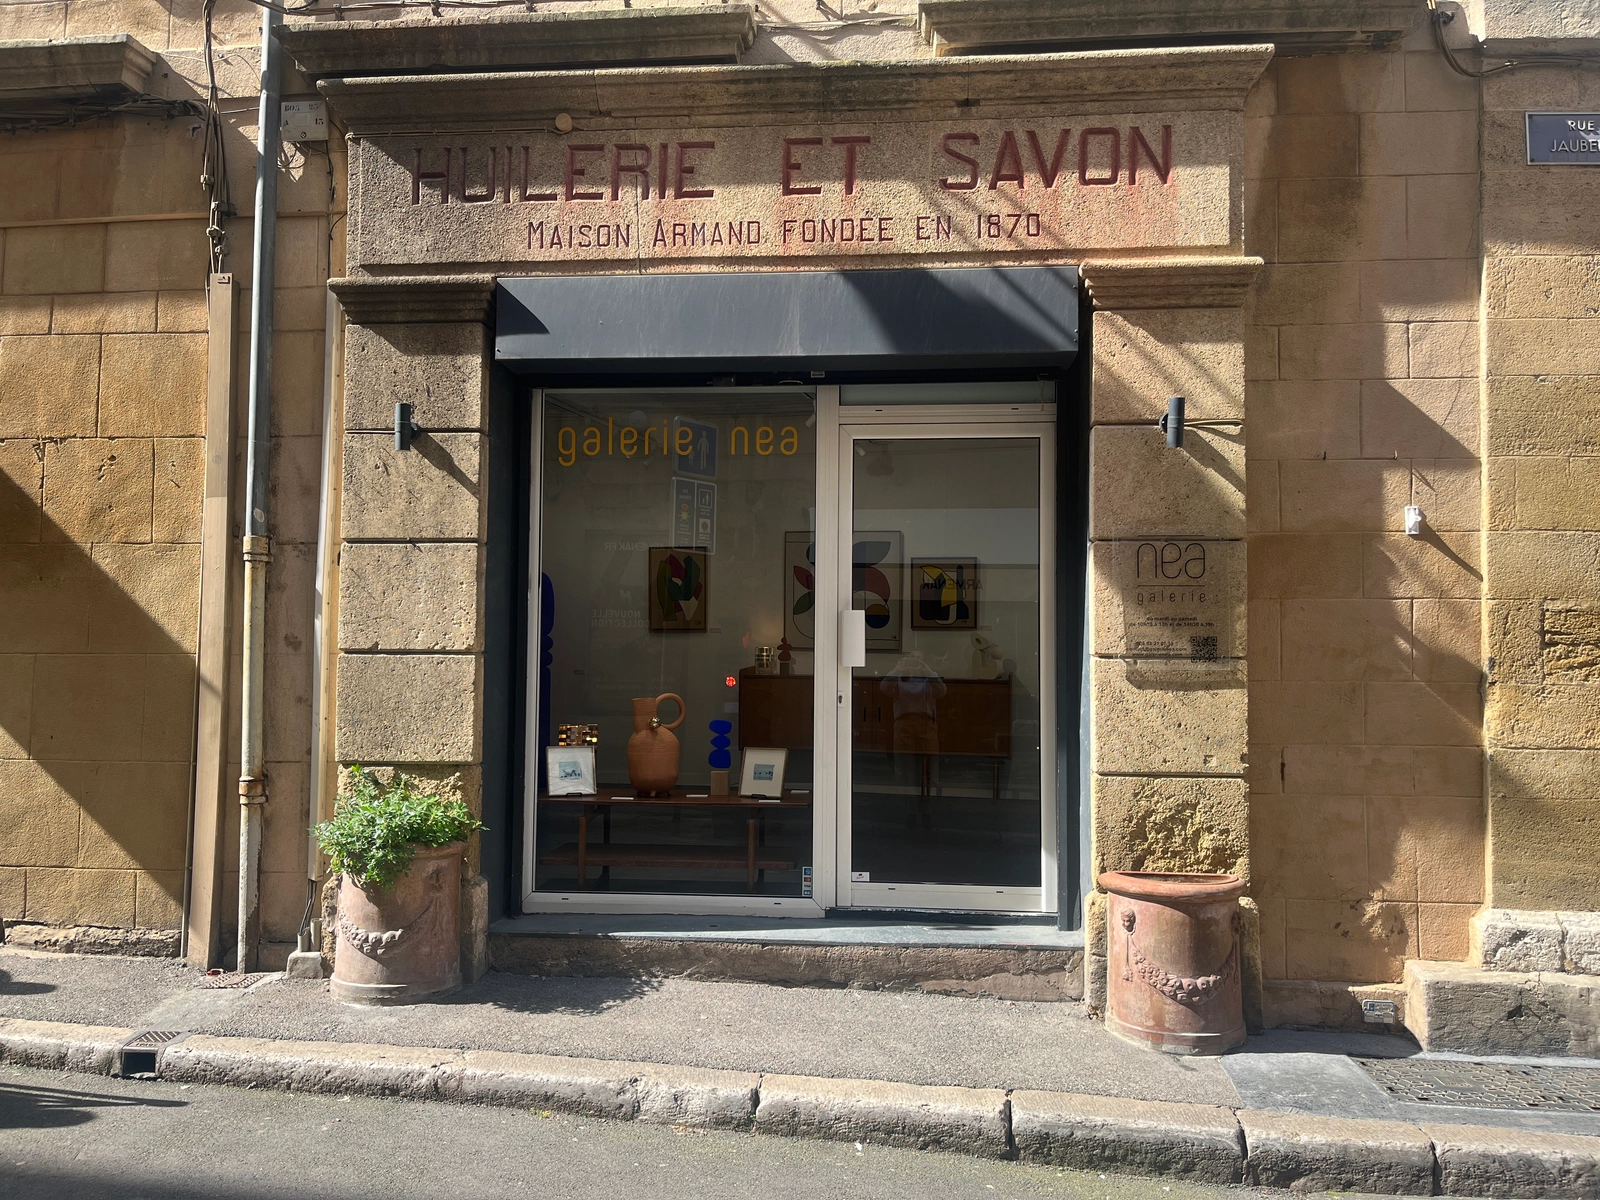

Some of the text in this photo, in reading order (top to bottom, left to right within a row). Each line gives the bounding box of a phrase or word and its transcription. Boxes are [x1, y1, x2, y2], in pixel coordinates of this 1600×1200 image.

[1567, 120, 1595, 131] RUE
[411, 125, 1172, 205] HUILERIE ET SAVON
[527, 221, 631, 250] MAISON
[653, 218, 761, 248] ARMAND
[916, 215, 952, 241] EN
[976, 213, 1042, 239] 1870
[557, 416, 799, 468] galerie nea
[1136, 543, 1206, 579] nea
[1137, 589, 1207, 606] galerie
